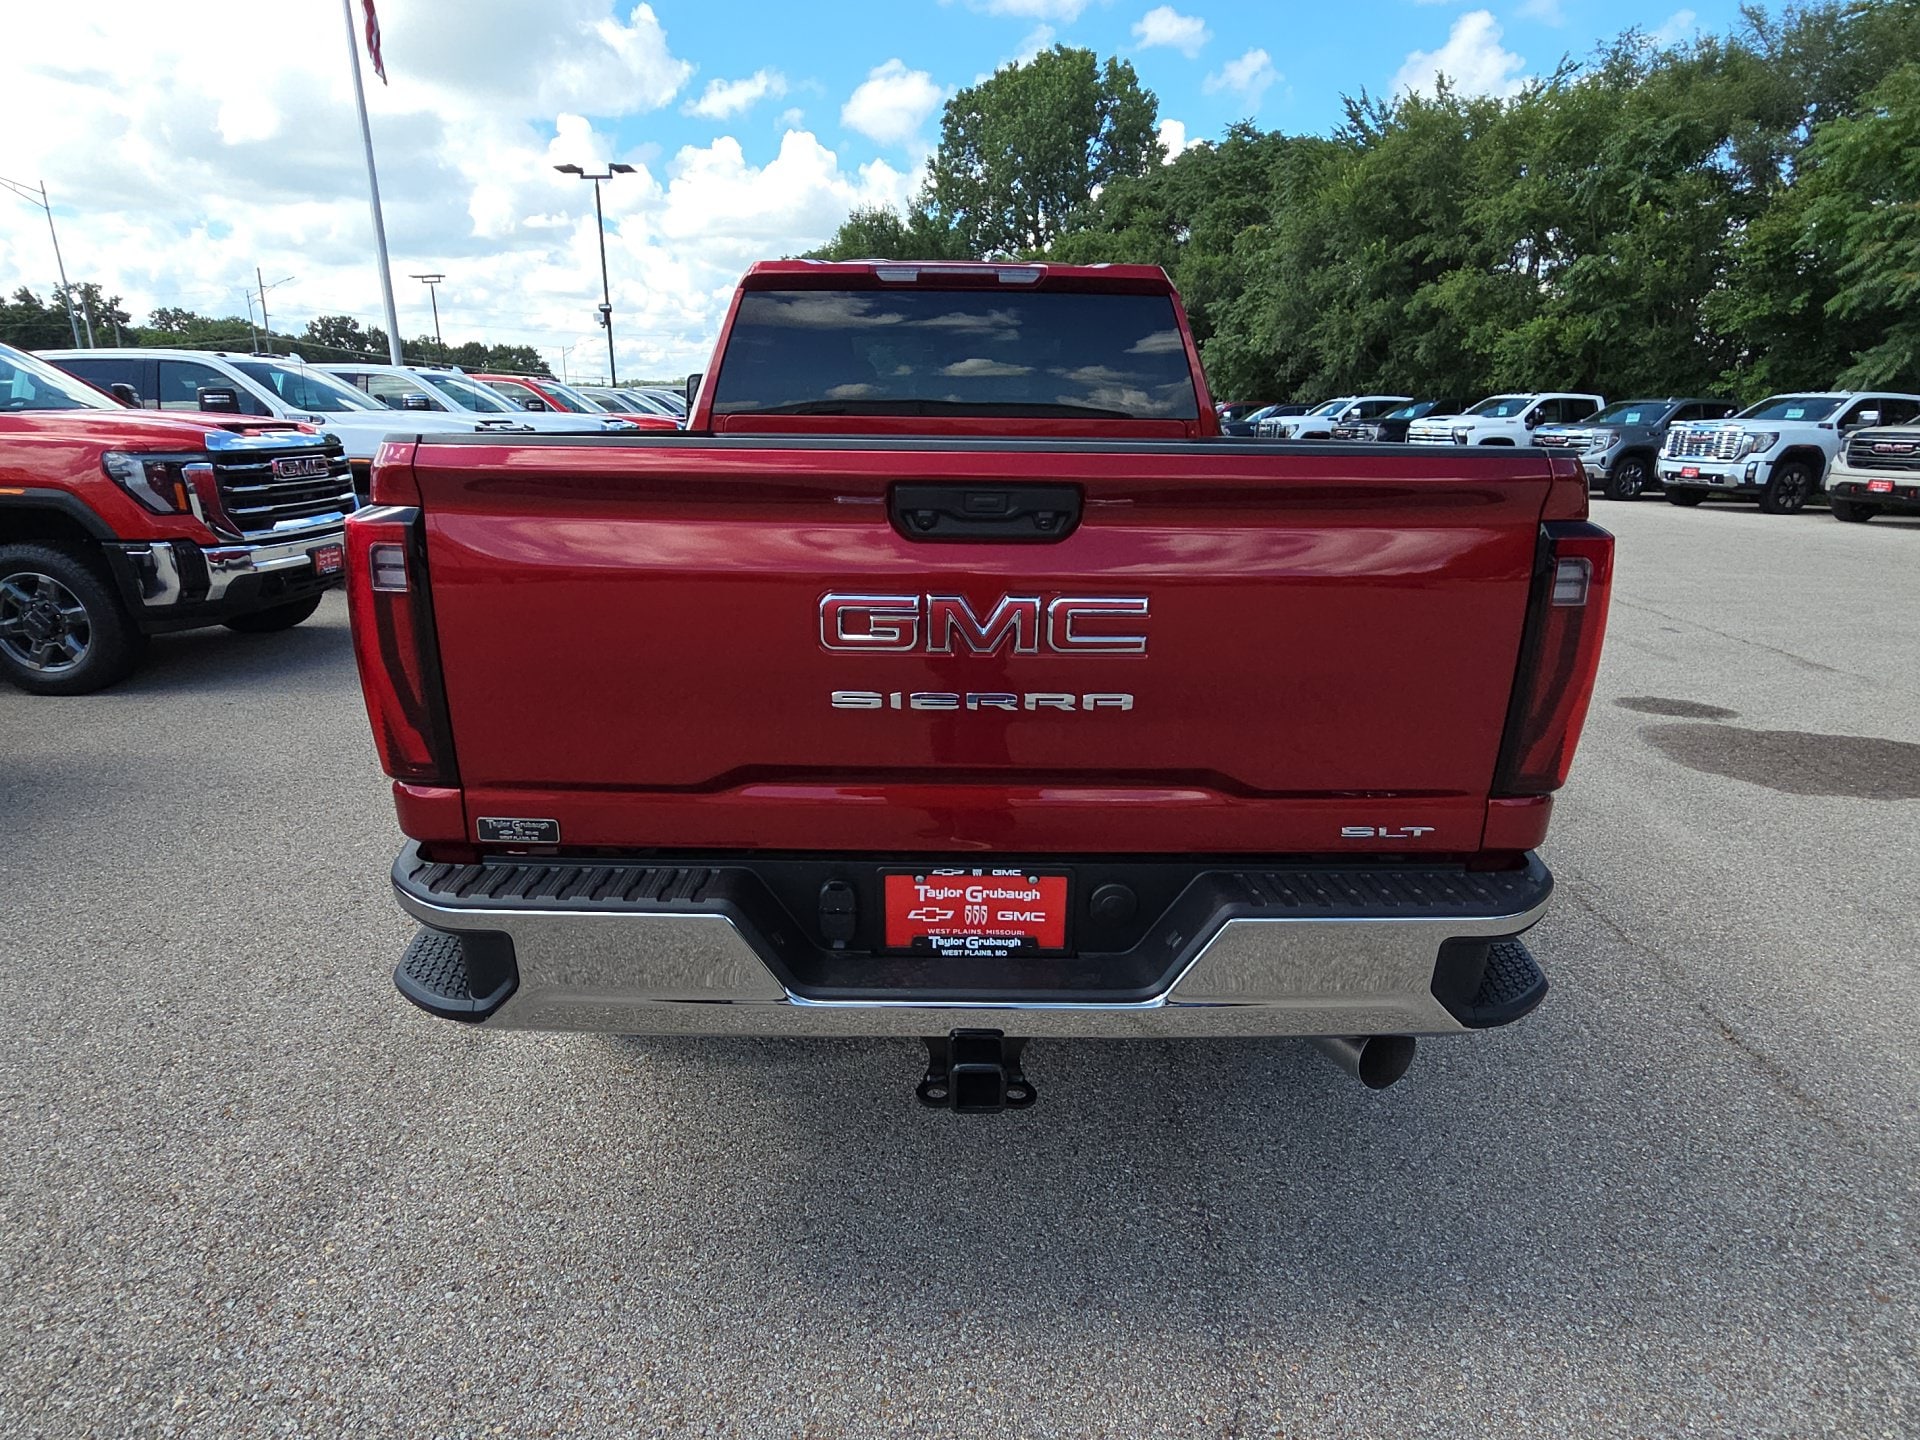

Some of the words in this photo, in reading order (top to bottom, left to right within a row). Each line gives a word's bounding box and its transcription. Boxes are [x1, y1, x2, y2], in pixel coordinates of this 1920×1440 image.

[1873, 443, 1914, 452] GMC
[279, 459, 329, 477] GMC
[818, 592, 1150, 655] GMC
[831, 690, 1134, 711] SIERRA
[1341, 826, 1435, 837] SLT
[914, 885, 963, 902] Taylor
[965, 886, 1041, 903] Grubaugh
[997, 911, 1046, 922] GMC
[928, 936, 965, 949] Taylor
[965, 936, 1022, 949] Grubaugh
